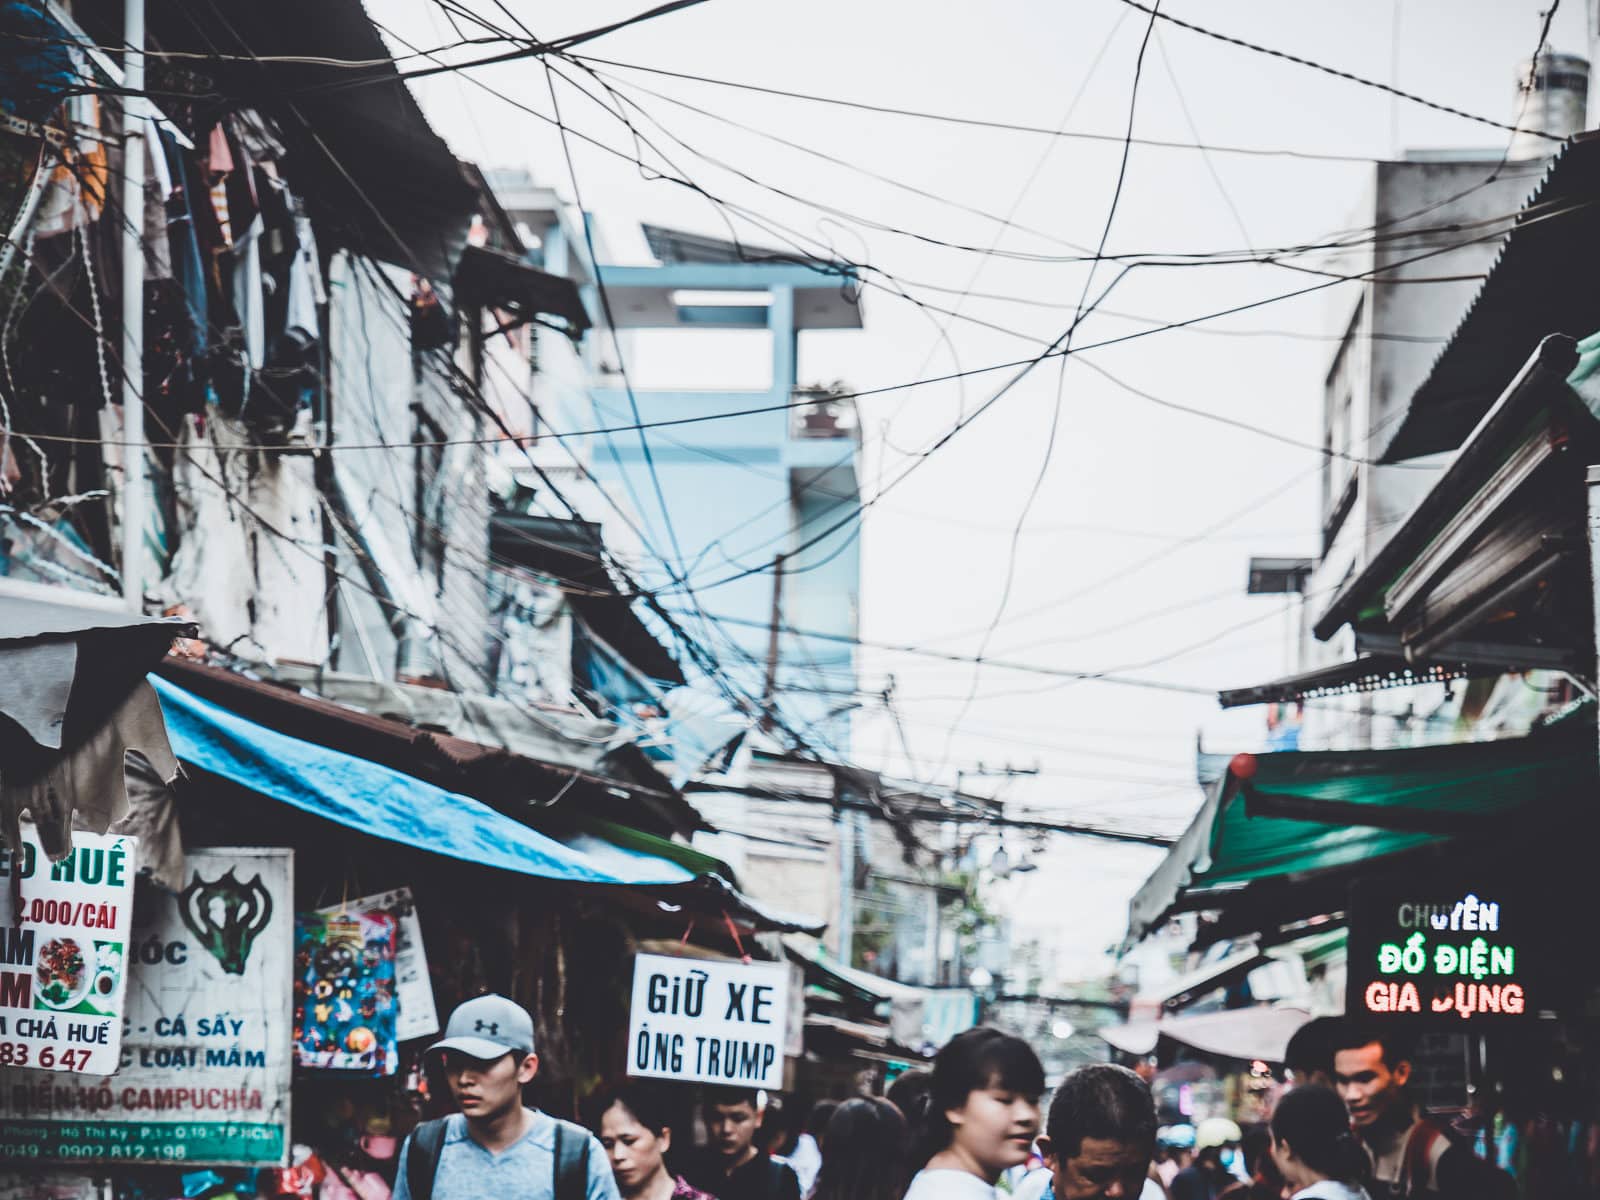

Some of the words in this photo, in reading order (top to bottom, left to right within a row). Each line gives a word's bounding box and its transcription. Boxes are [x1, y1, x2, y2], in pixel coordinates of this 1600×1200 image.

[51, 839, 126, 887] HUẾ
[1398, 893, 1499, 931] CHUYÊN
[1434, 937, 1515, 980] ĐIỆN
[725, 982, 773, 1024] XE
[1365, 981, 1421, 1012] GIA
[16, 1015, 59, 1040] CHẢ
[67, 1020, 111, 1045] HUẾ
[155, 1013, 187, 1037] CÁ
[695, 1037, 775, 1081] TRUMP
